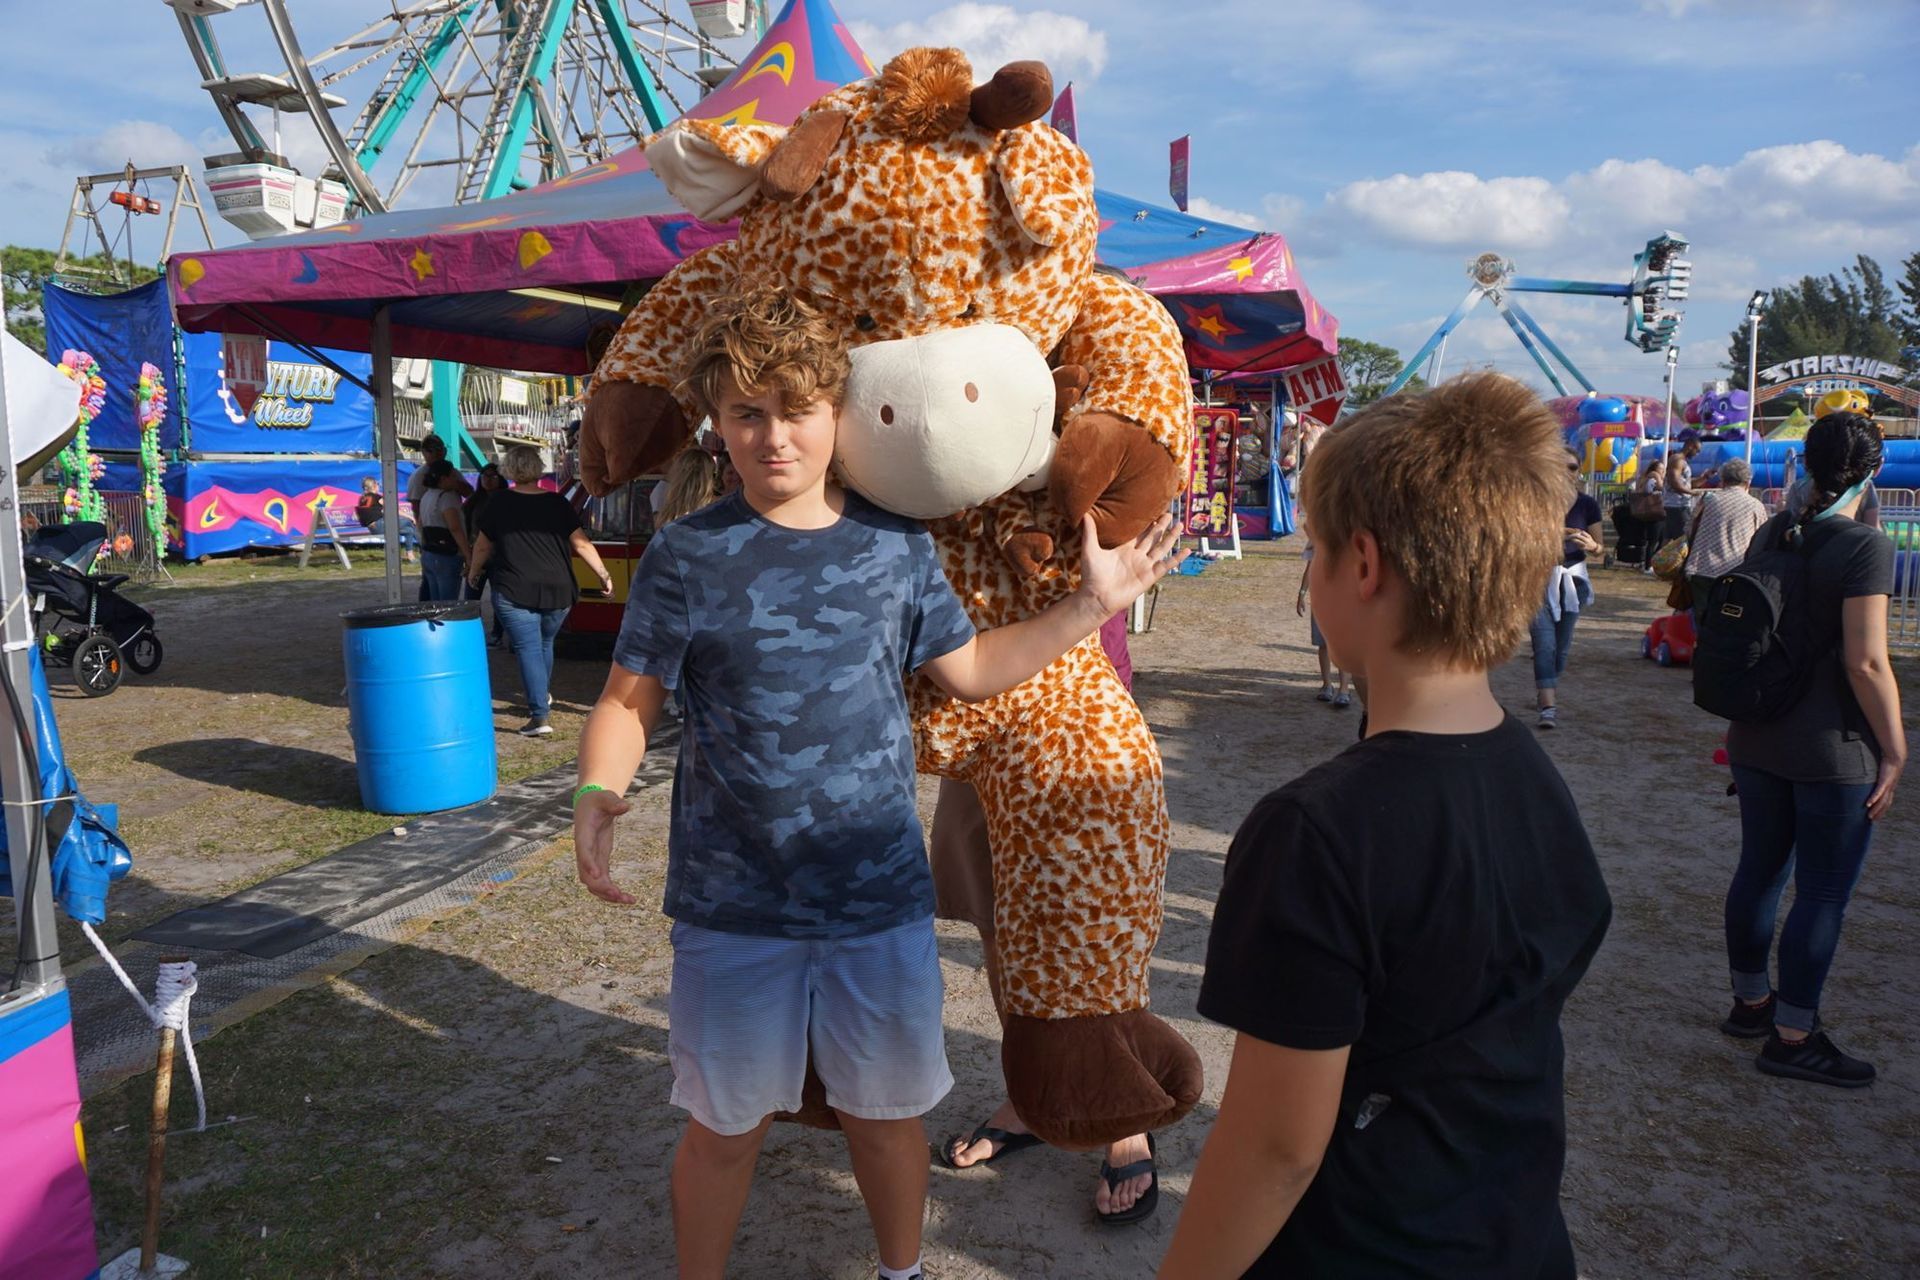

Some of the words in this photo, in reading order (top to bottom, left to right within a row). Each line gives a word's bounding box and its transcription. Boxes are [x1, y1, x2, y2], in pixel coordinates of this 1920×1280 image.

[226, 340, 265, 382] ATM
[265, 361, 340, 398] NTURY
[1758, 355, 1908, 383] STARSHIP
[1288, 359, 1345, 407] ATM
[255, 398, 313, 427] Wheel
[1210, 492, 1227, 532] ART
